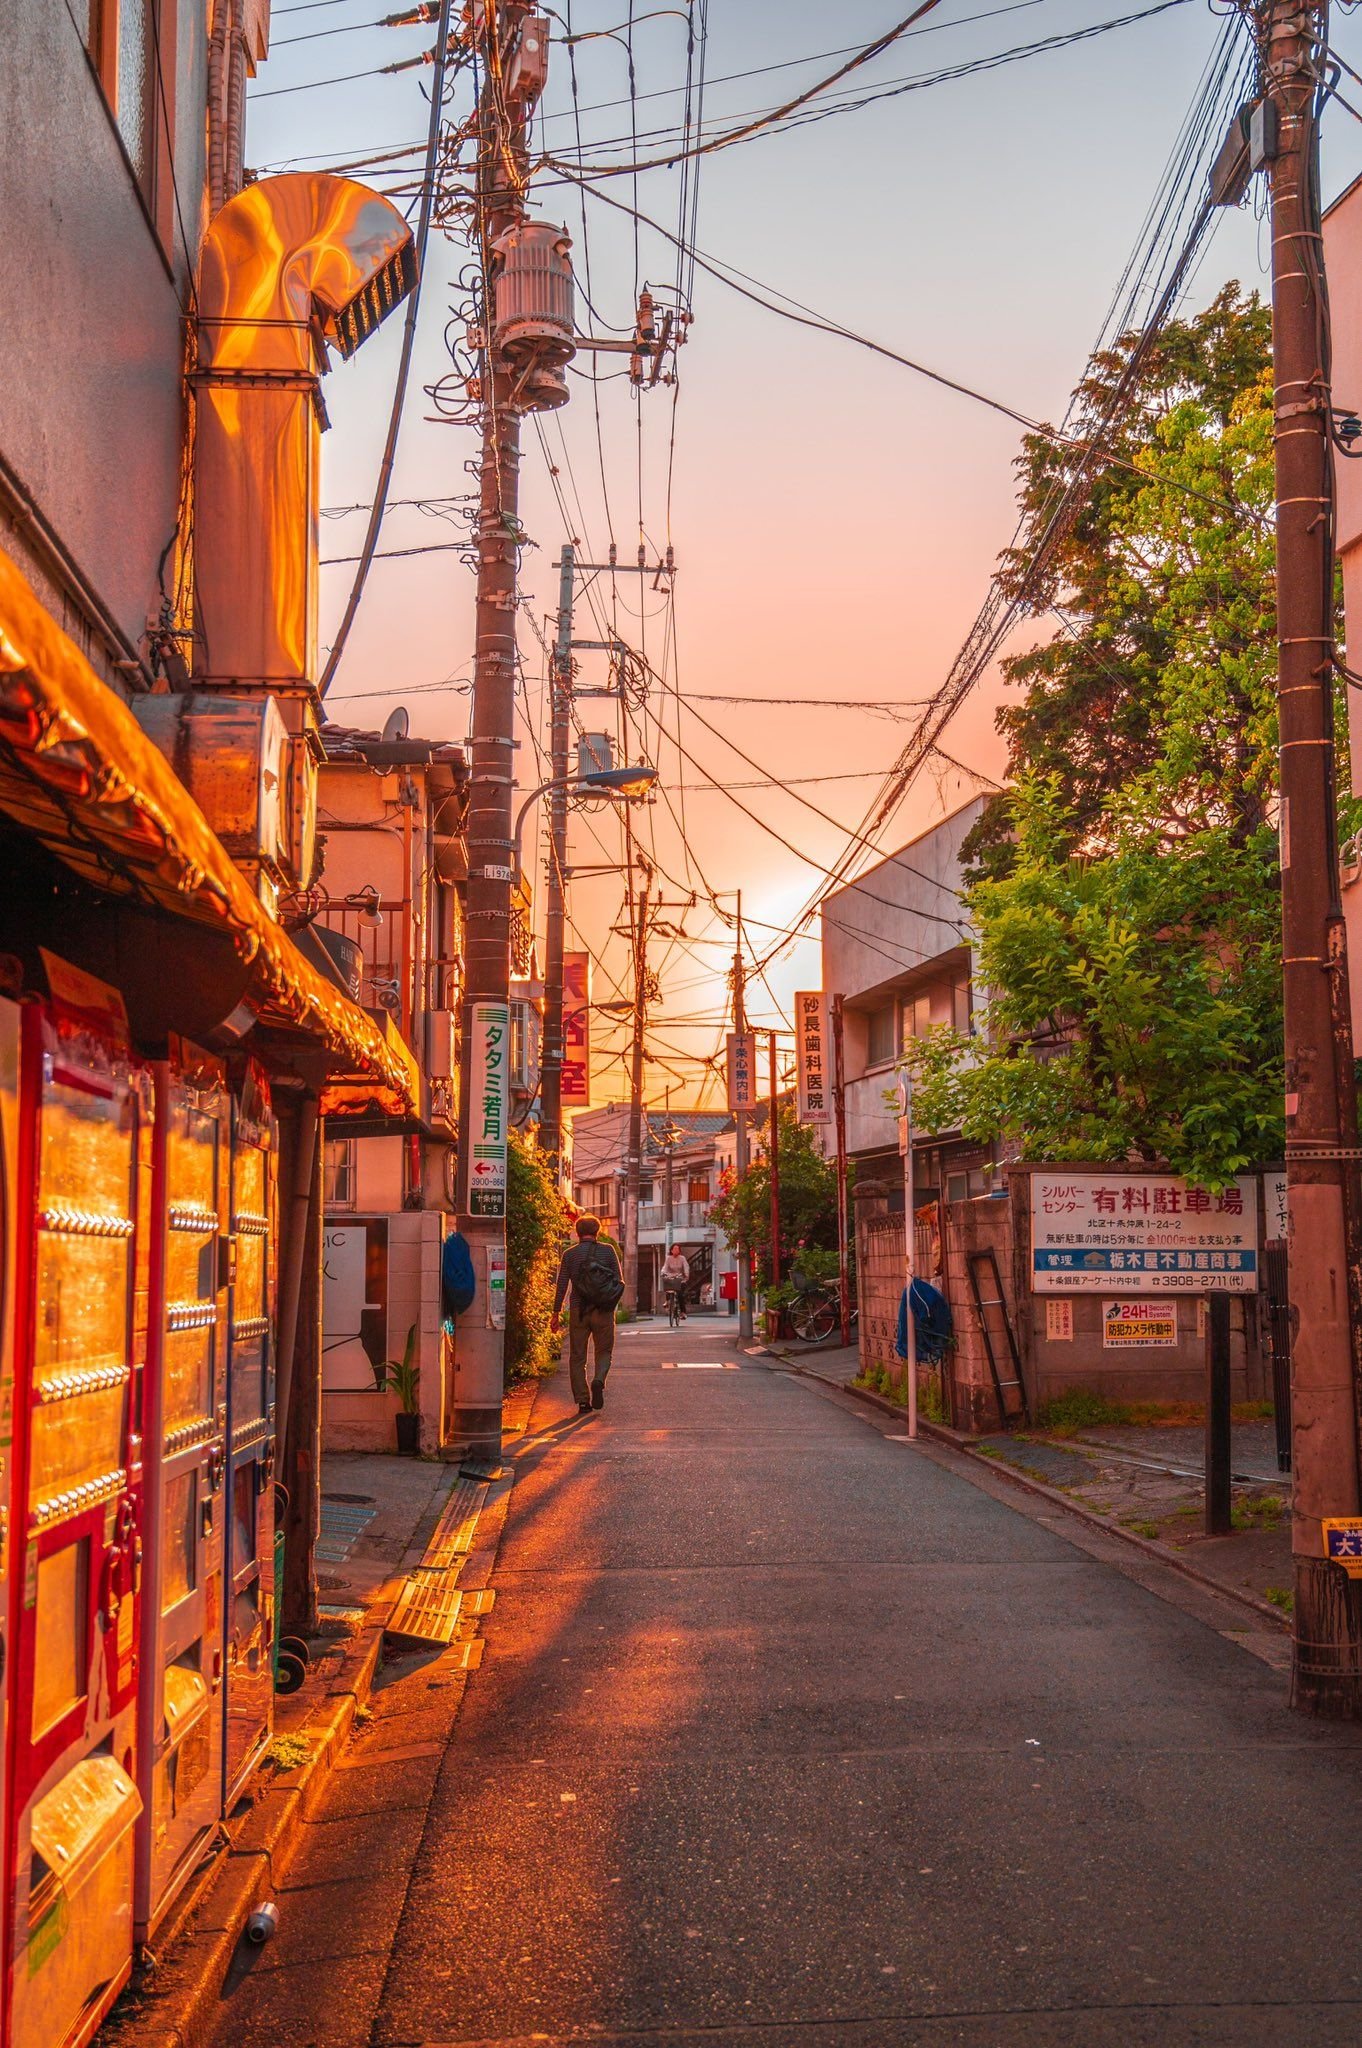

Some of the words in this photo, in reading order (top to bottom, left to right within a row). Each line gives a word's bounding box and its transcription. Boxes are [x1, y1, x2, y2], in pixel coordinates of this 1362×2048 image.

[803, 997, 823, 1110] 砂長歯科医院
[735, 1037, 748, 1102] 十条心療内科
[482, 1026, 503, 1140] タタミ若月
[490, 1165, 505, 1173] 入口
[1041, 1186, 1085, 1198] シルバー
[1043, 1201, 1085, 1213] センター
[1092, 1186, 1244, 1216] 有料駐車場
[482, 1205, 498, 1213] 1-5
[1047, 1254, 1075, 1267] 管理
[1109, 1251, 1243, 1270] 栃木屋不動産商事
[1121, 1304, 1149, 1319] 24H
[1109, 1323, 1172, 1336] 防犯カメラ作動中
